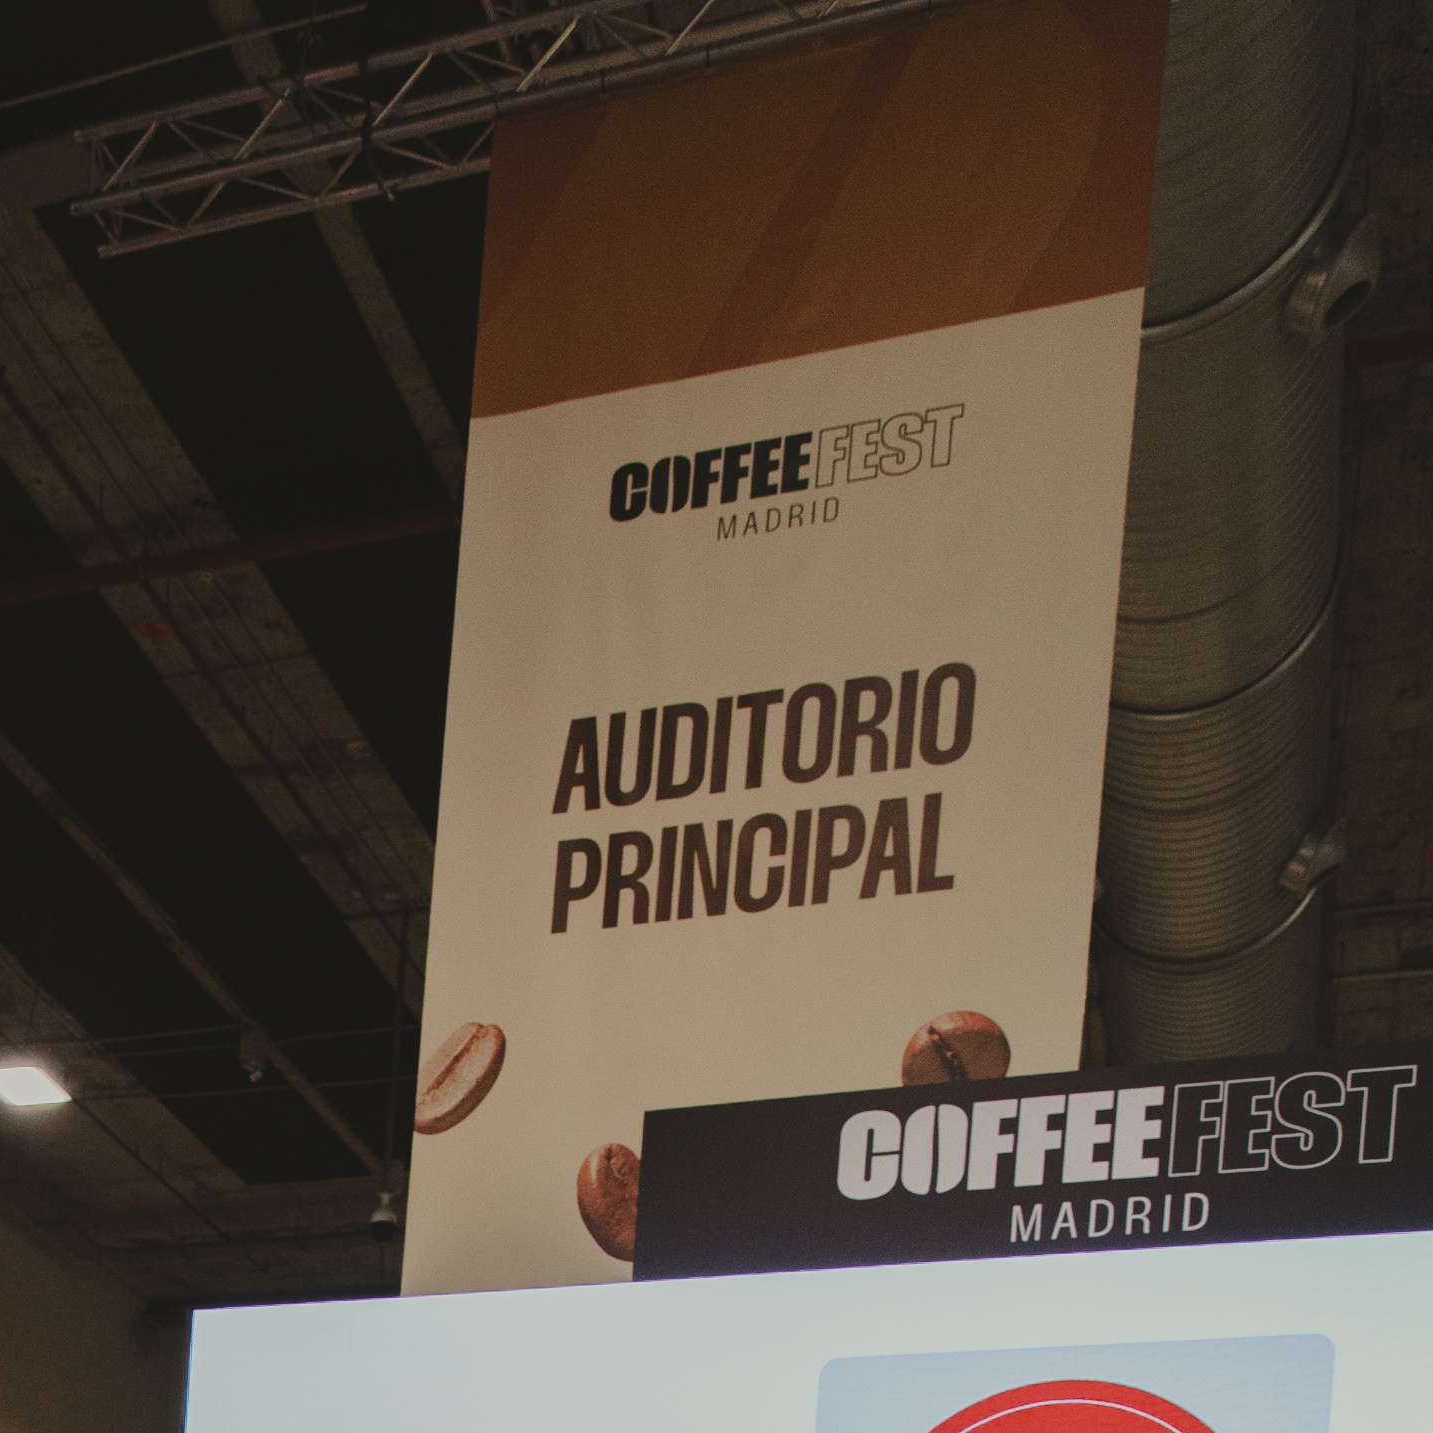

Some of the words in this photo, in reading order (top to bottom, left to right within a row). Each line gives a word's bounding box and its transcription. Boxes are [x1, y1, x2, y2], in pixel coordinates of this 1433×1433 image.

[717, 498, 839, 540] MADRID
[552, 662, 977, 813] AUDITORIO
[550, 793, 953, 934] PRINCIPAL
[1010, 1193, 1209, 1243] MADRID
